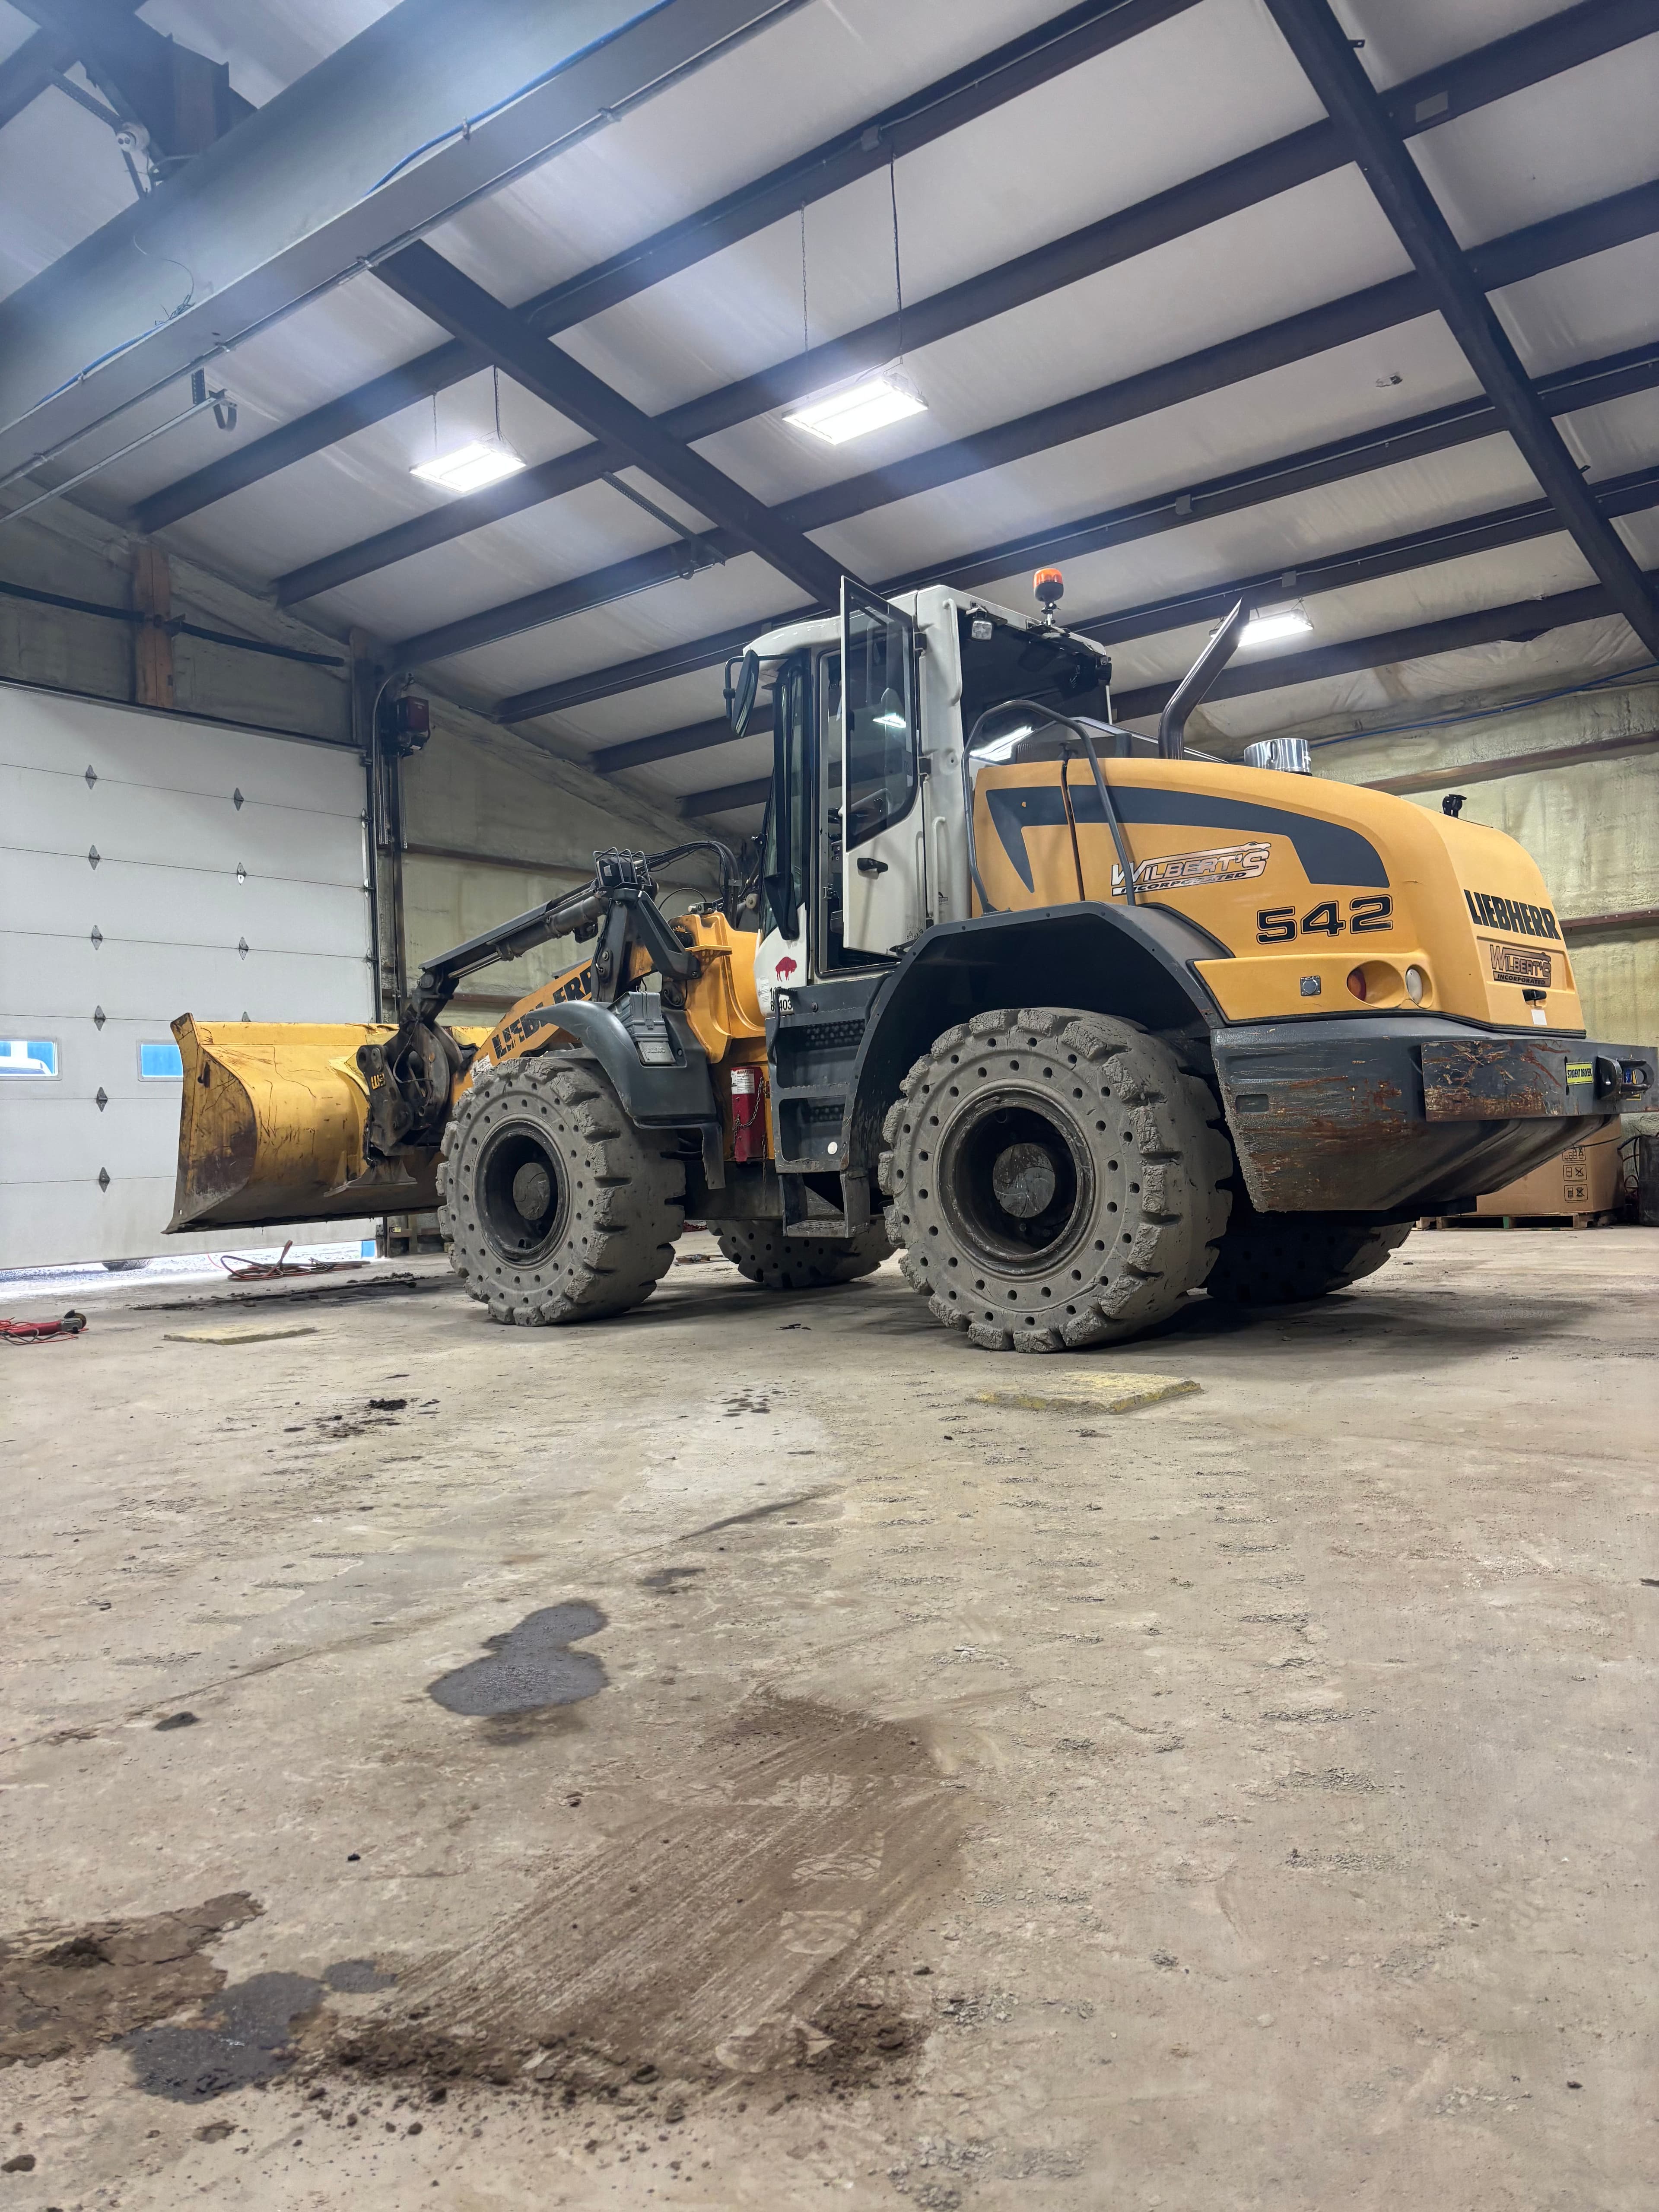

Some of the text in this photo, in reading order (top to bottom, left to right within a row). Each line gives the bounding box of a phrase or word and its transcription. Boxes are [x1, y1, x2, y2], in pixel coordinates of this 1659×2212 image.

[1256, 894, 1393, 945] 542
[1464, 889, 1561, 941] LIEBHERR
[1490, 944, 1552, 978] WILBERT'S
[1497, 974, 1546, 985] INCORPORATED
[1567, 1068, 1592, 1078] STUDENT DRIVER
